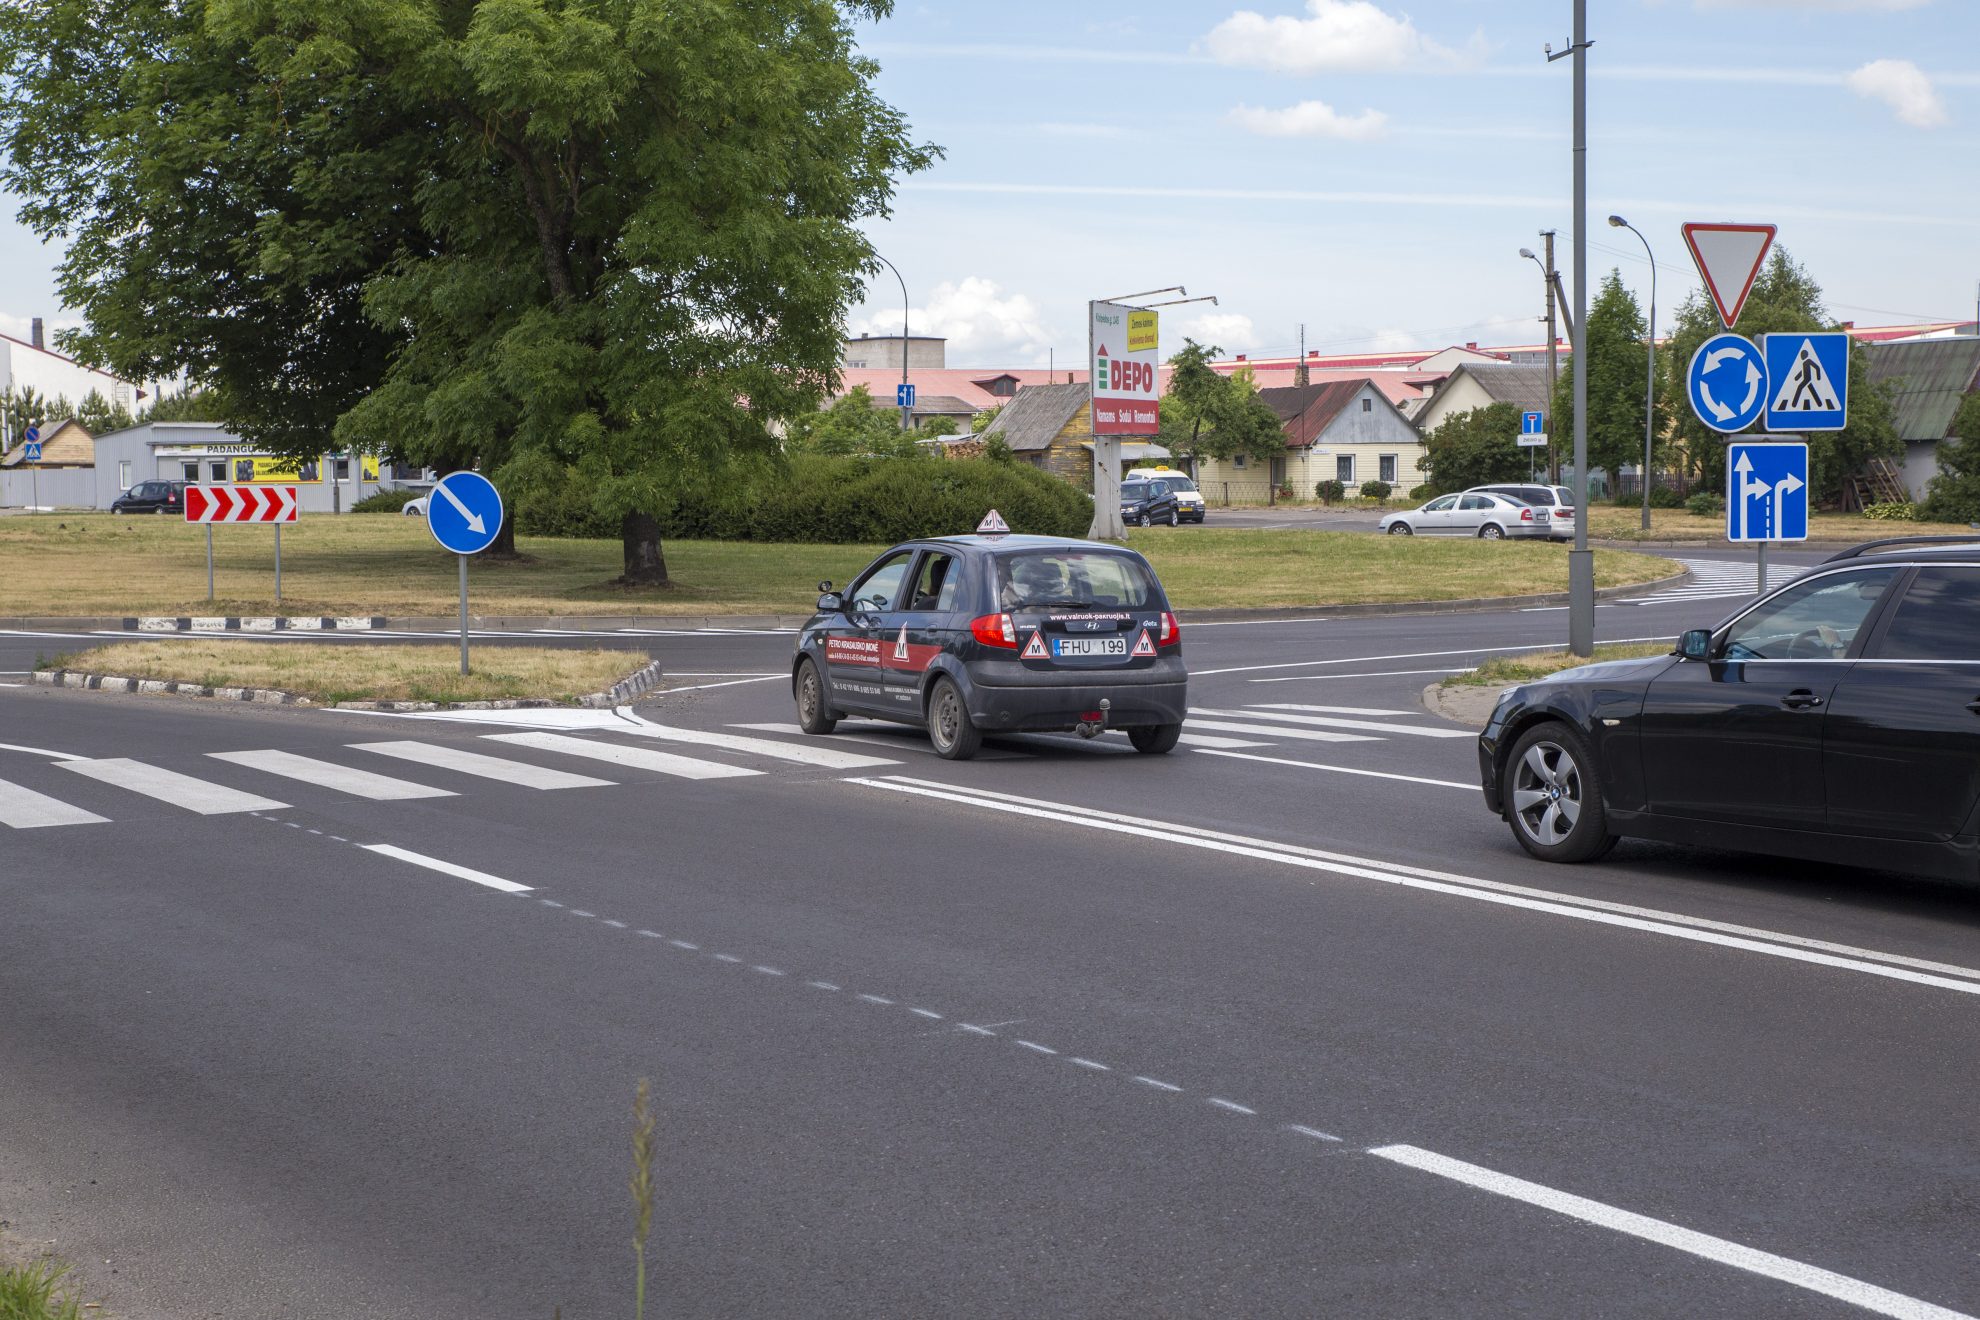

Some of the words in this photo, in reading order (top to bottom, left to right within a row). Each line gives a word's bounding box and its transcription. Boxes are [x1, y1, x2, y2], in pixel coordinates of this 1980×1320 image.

[1111, 360, 1152, 393] DEPO
[1119, 409, 1132, 423] Sodui
[829, 640, 841, 648] PETRO
[897, 642, 905, 657] M
[1031, 644, 1040, 654] M
[1061, 640, 1090, 654] FHU
[1102, 640, 1124, 653] 199
[1140, 642, 1148, 651] M
